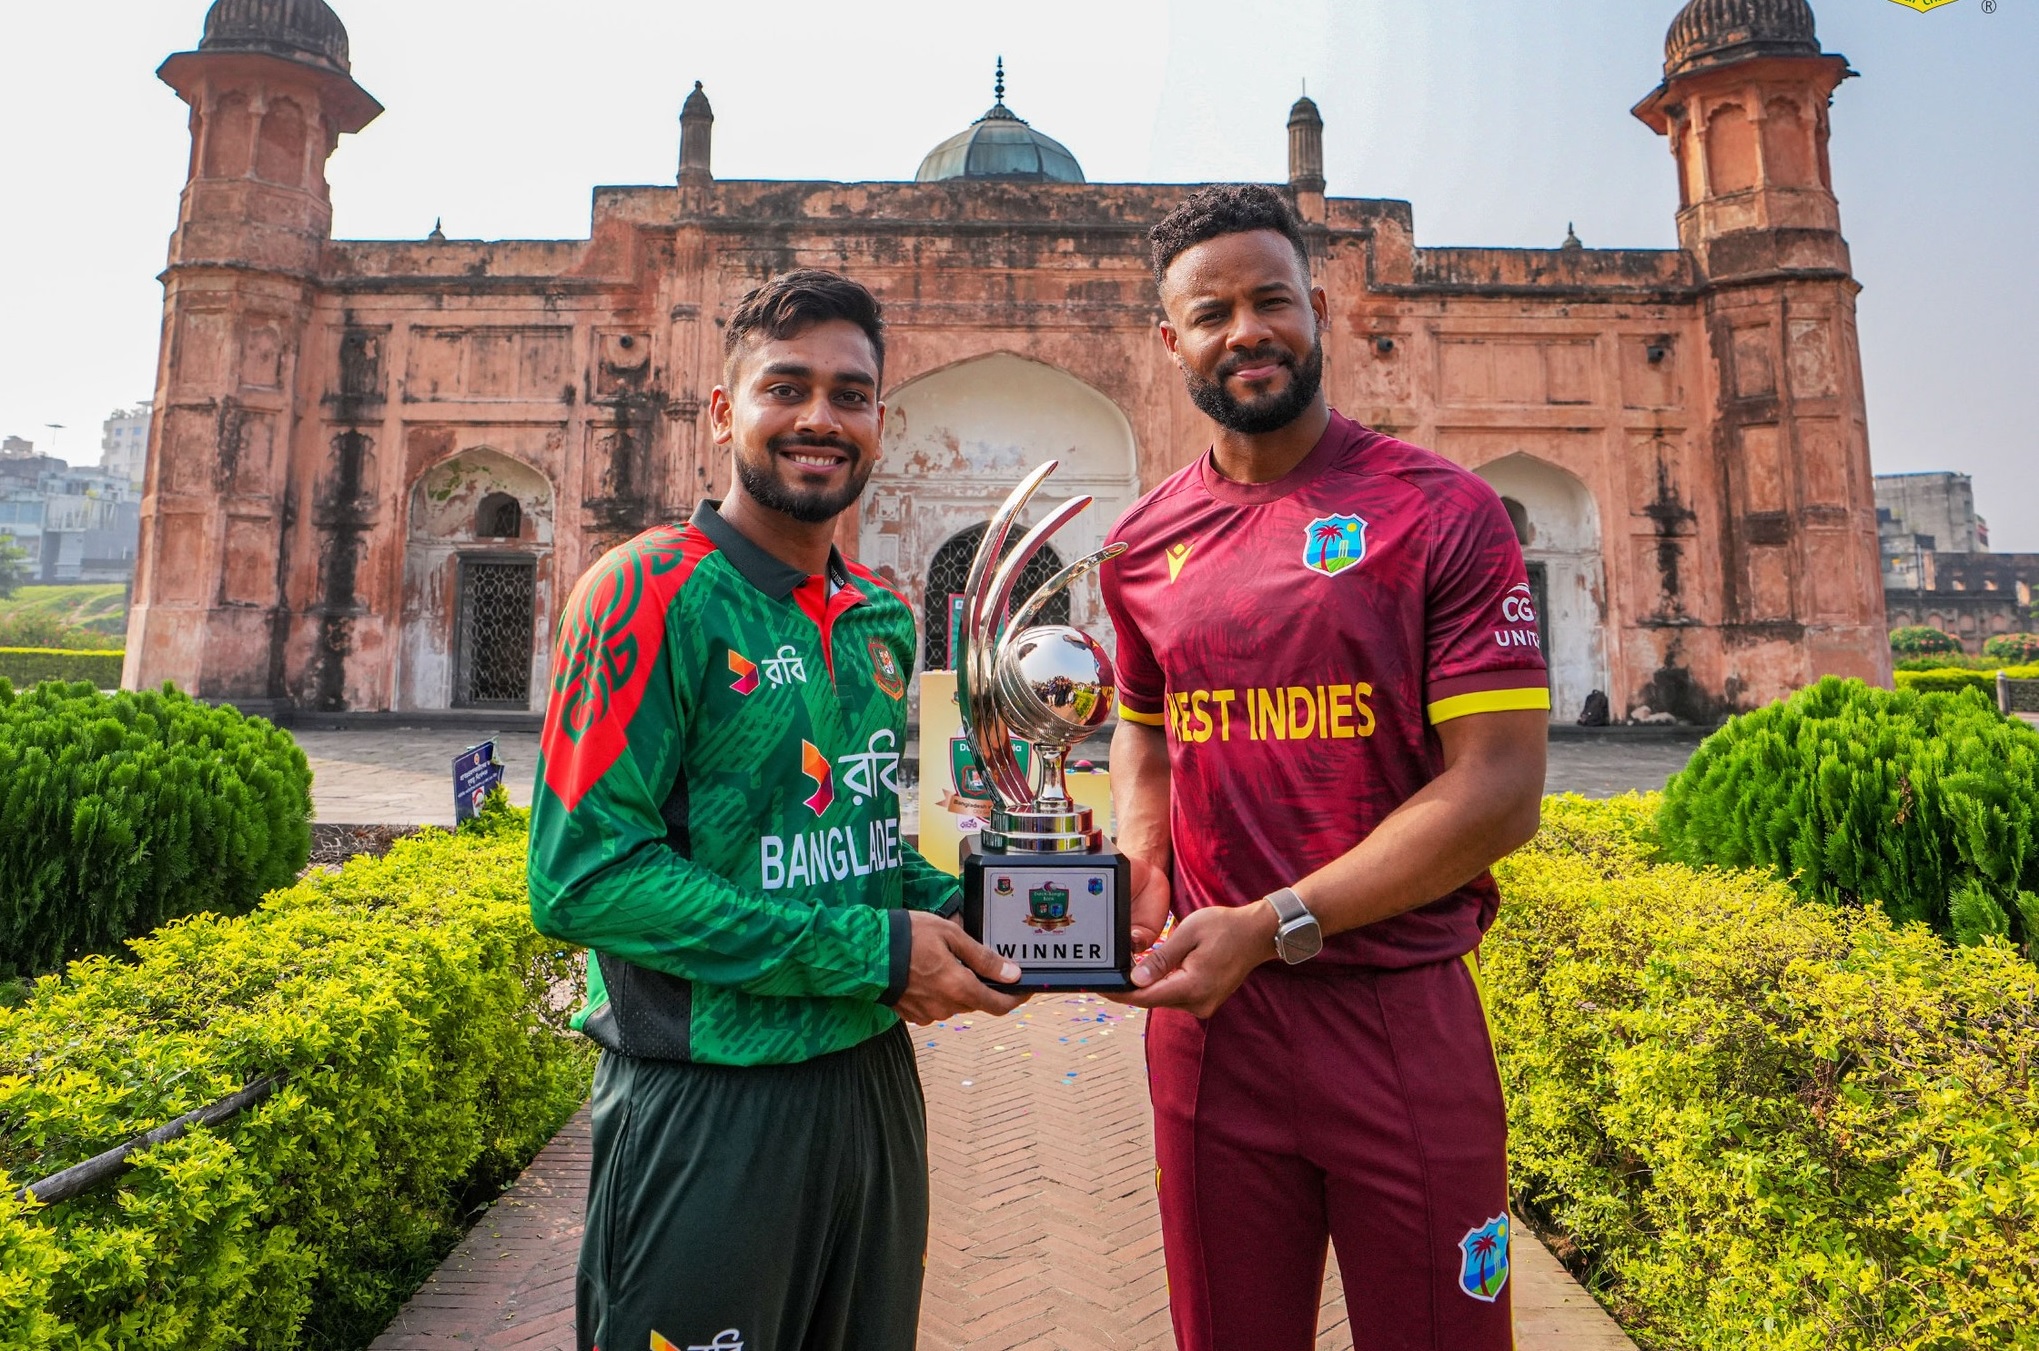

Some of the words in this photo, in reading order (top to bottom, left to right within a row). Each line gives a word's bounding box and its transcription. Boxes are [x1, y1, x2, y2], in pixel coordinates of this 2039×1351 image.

[1494, 630, 1540, 649] UNIT
[761, 645, 807, 690] রবি
[1247, 682, 1376, 741] INDIES
[761, 818, 902, 890] BANGLADE
[996, 944, 1101, 959] WINNER
